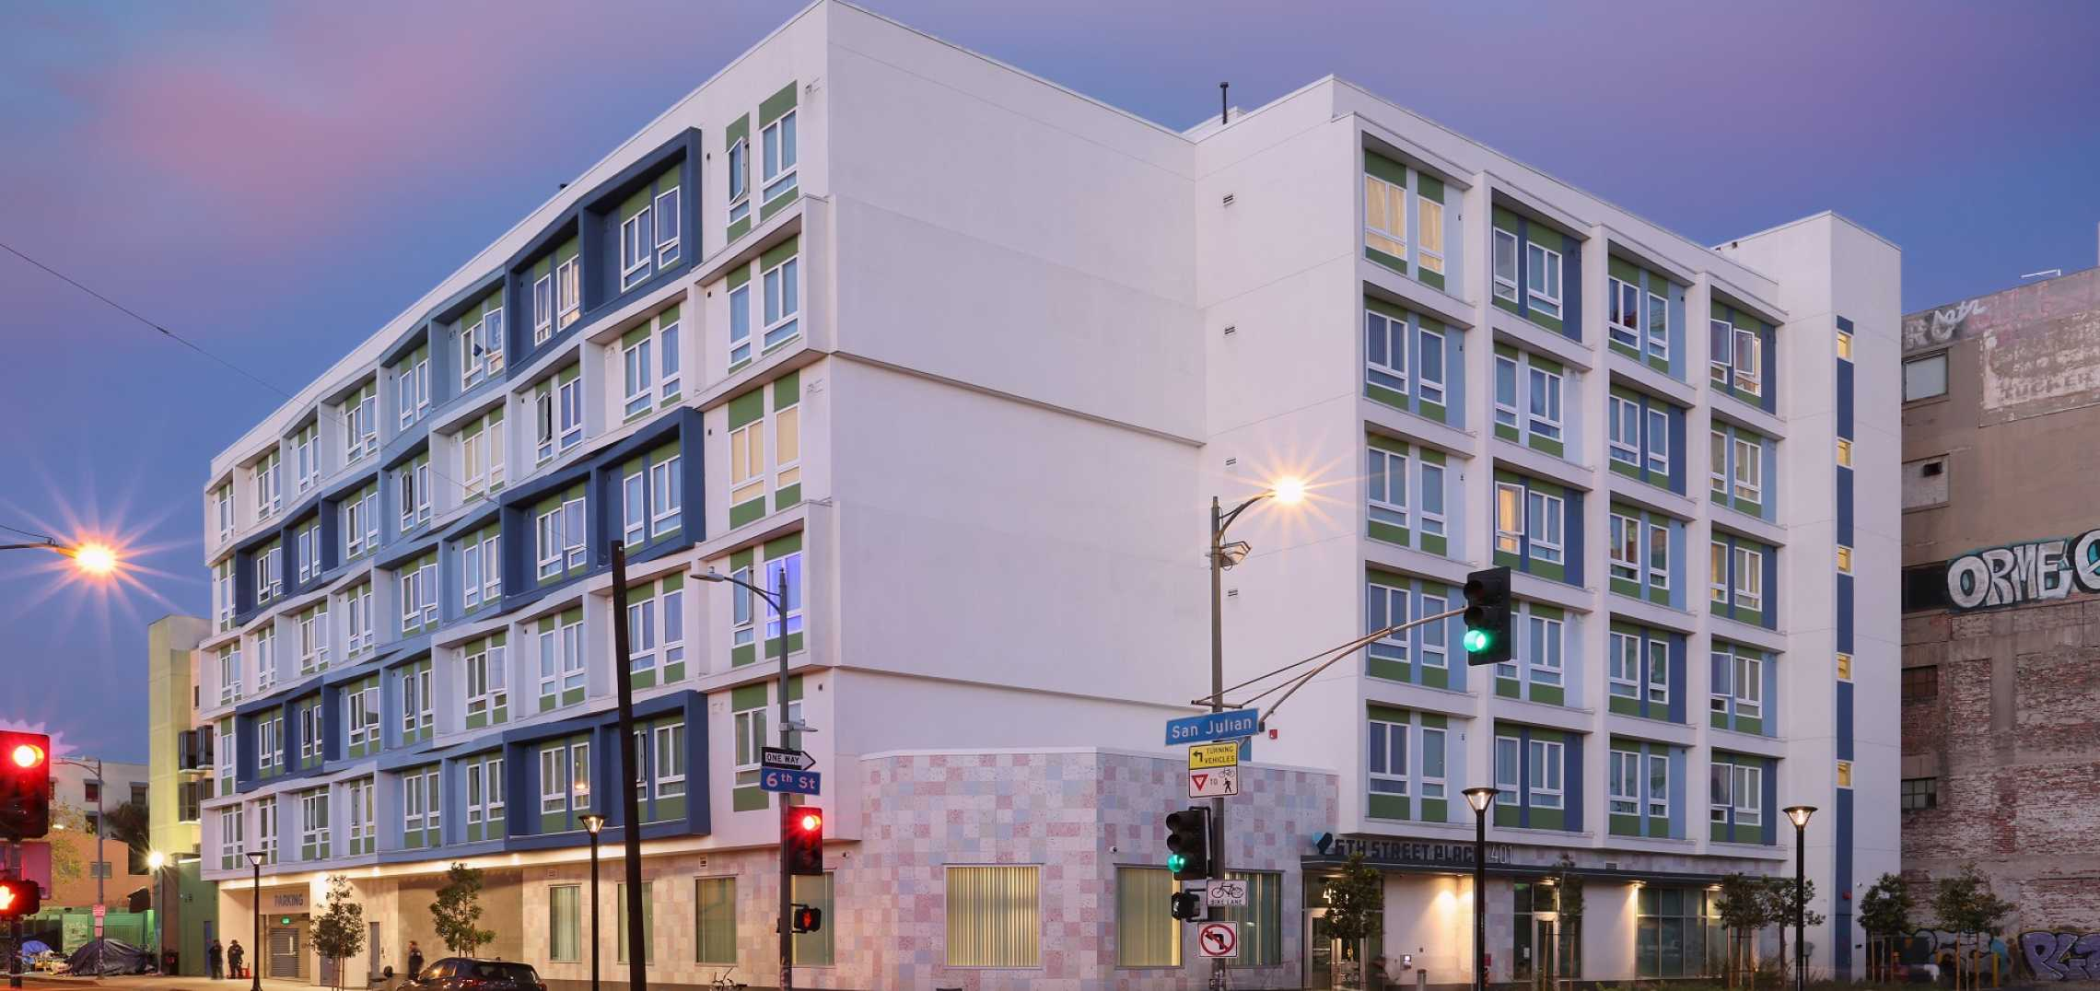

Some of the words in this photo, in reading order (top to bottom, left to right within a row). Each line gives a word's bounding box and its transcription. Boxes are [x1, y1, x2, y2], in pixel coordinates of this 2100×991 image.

[1171, 725, 1199, 739] San
[1205, 717, 1252, 735] Julian
[1206, 746, 1234, 755] TURNING
[766, 753, 782, 763] ONE
[784, 755, 800, 765] WAY
[1204, 755, 1235, 764] VEHICLES
[766, 772, 793, 788] 6th
[798, 776, 816, 789] St
[1371, 840, 1430, 862] STREET
[1434, 844, 1478, 863] PLAC
[1489, 844, 1514, 864] 401
[274, 893, 304, 907] PARKING
